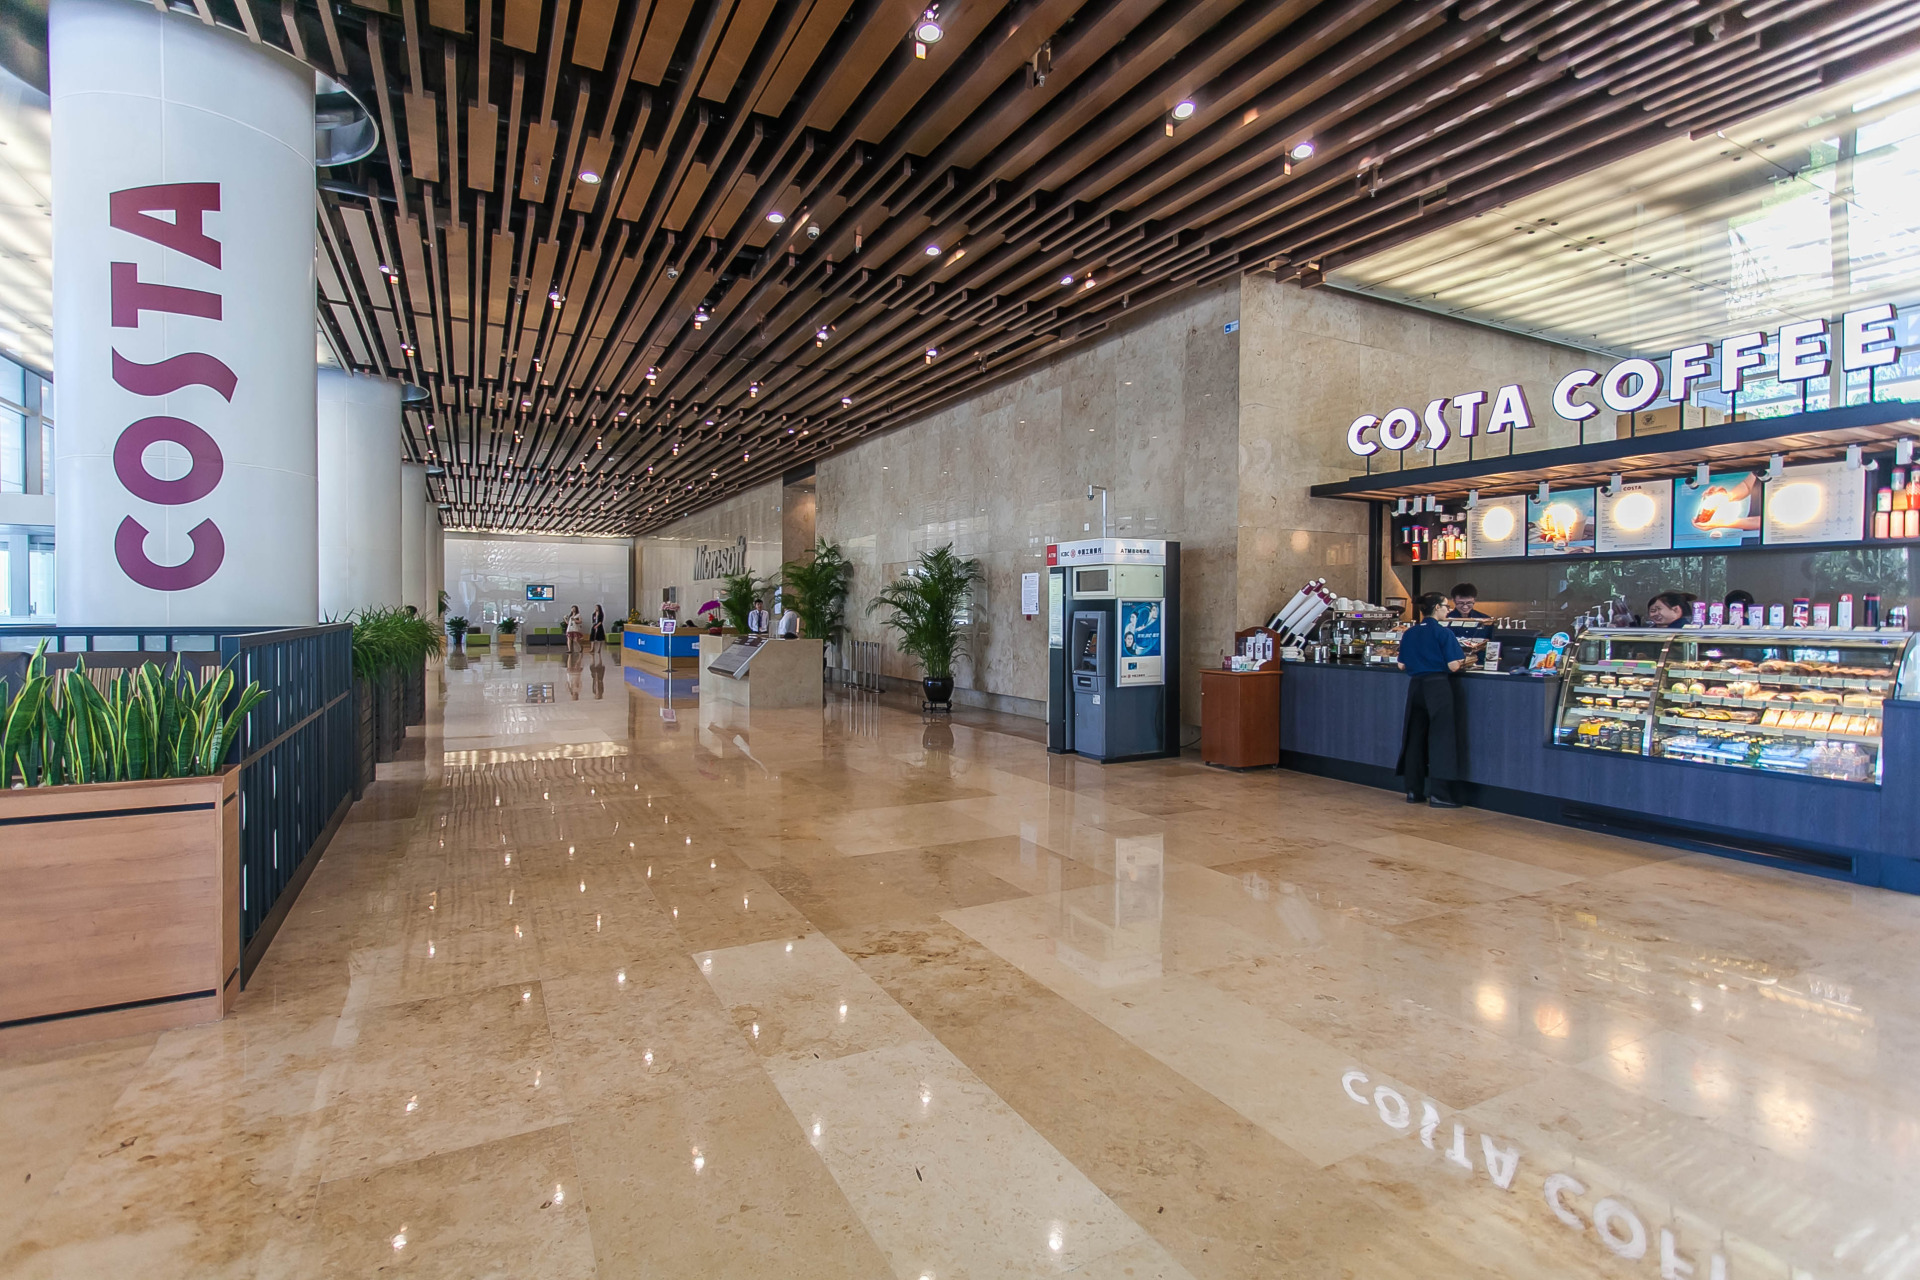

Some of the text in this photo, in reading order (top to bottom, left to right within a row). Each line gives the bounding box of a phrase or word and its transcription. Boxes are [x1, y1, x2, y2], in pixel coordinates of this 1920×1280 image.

[109, 182, 238, 591] COSTA
[1347, 303, 1900, 456] COSTA COFFEE
[694, 535, 747, 580] Microsoft
